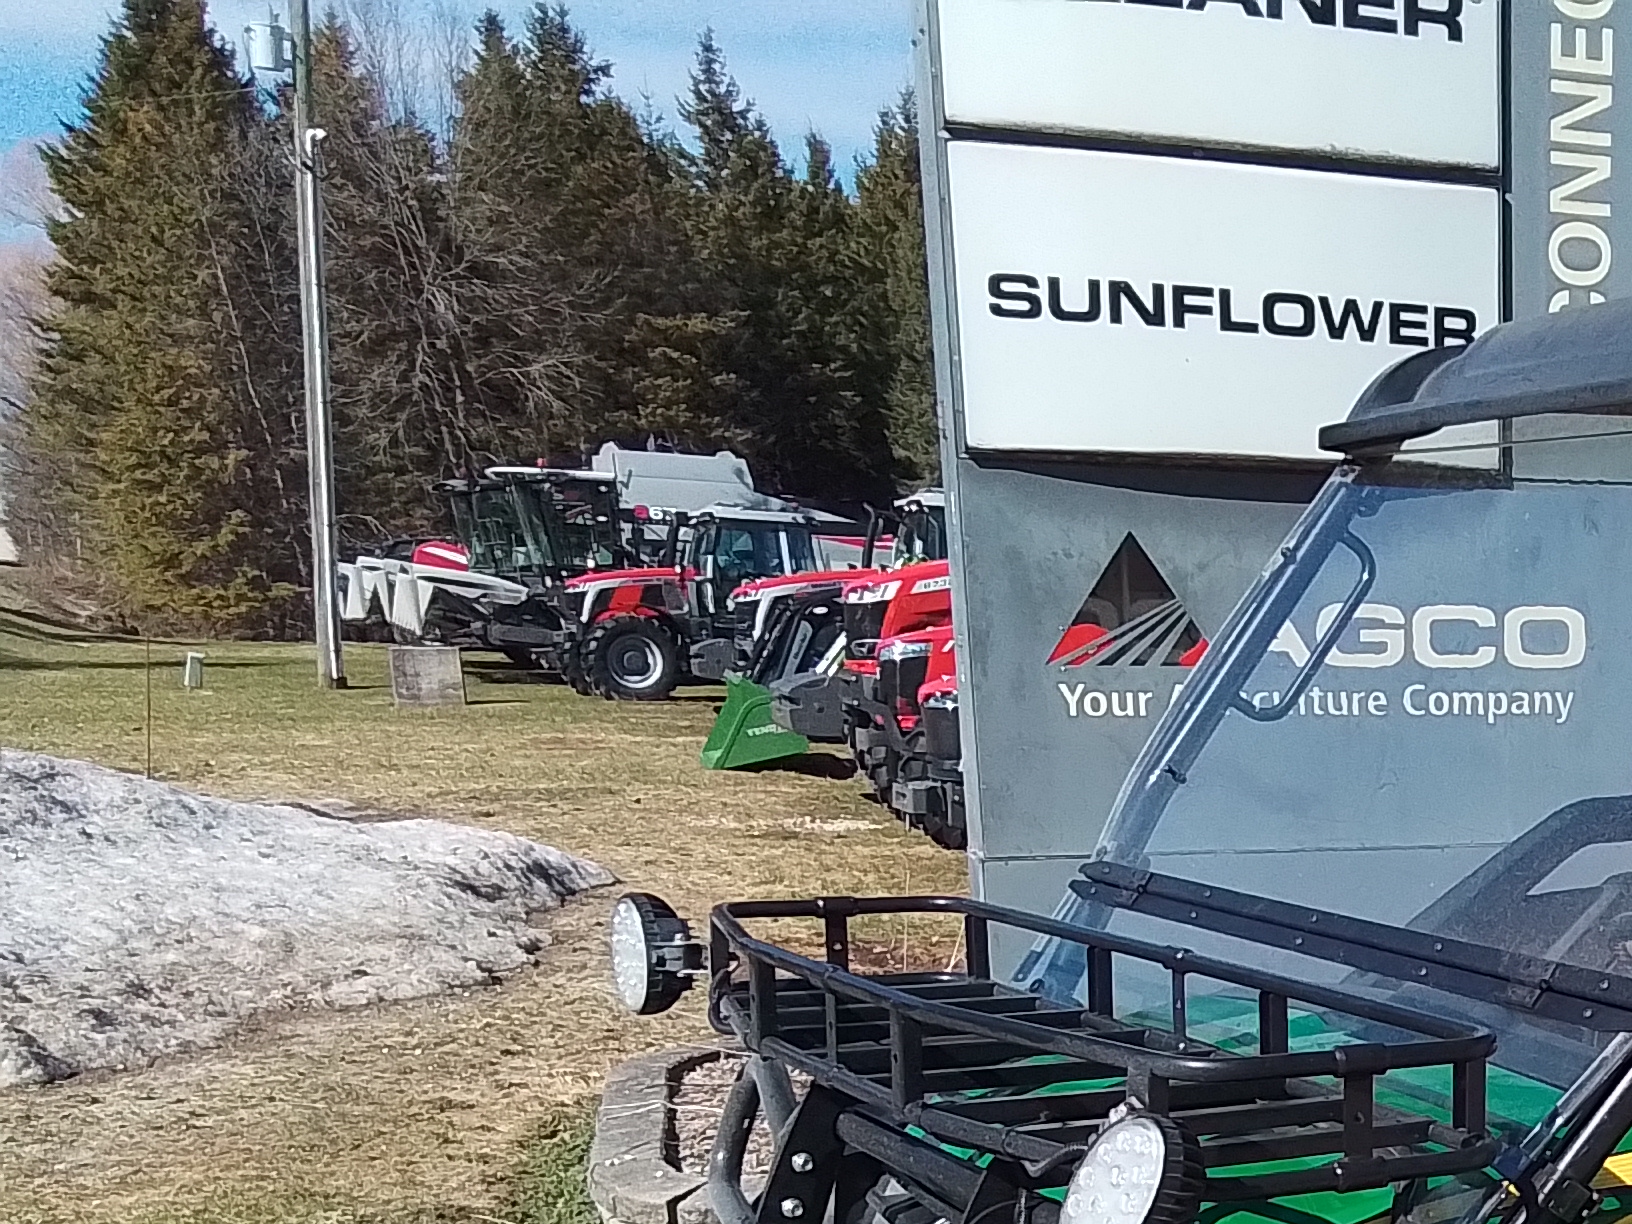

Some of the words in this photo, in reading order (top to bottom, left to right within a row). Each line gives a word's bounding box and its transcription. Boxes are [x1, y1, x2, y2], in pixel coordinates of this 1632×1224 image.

[987, 273, 1476, 347] SUNFLOWER
[1058, 683, 1153, 717] Your
[1402, 684, 1575, 723] Company
